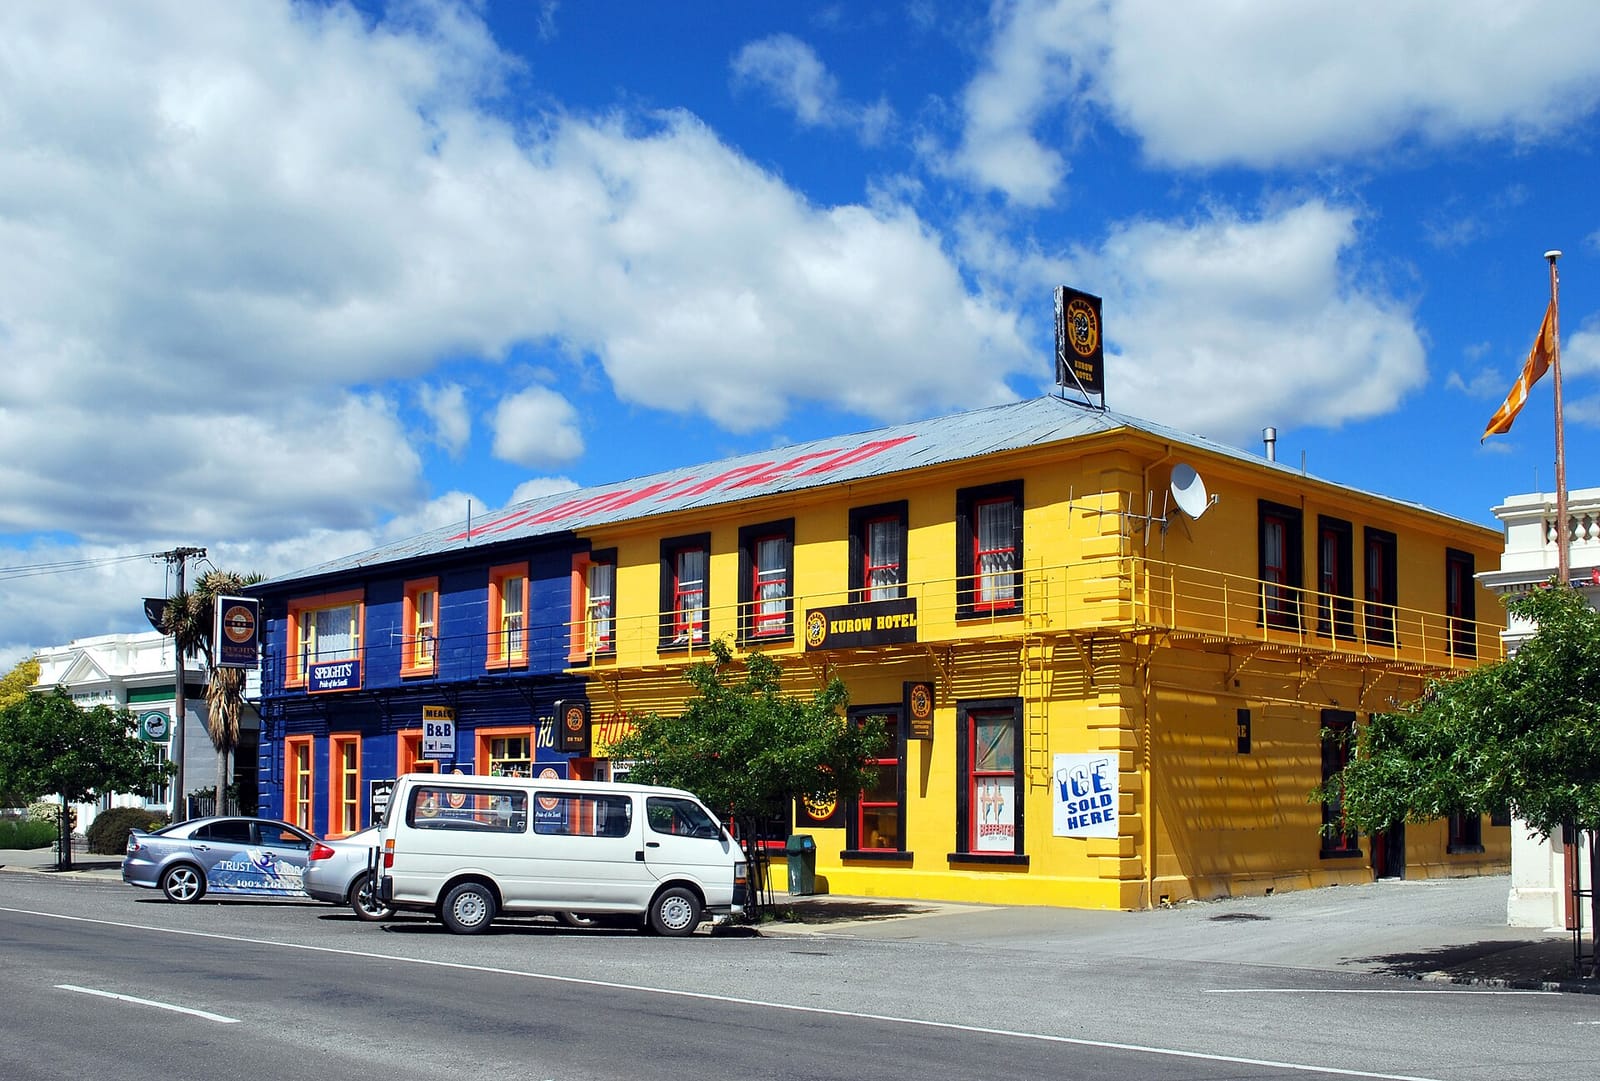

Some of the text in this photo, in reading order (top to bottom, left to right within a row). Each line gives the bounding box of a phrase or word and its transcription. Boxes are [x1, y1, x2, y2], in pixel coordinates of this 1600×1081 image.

[656, 435, 917, 503] RED
[830, 613, 917, 634] KUROW HOTEL
[314, 663, 353, 680] SPEIGHT'S
[425, 709, 454, 718] MEALS
[426, 723, 452, 737] B&B
[1056, 758, 1112, 802] ICE
[809, 805, 830, 817] BEER
[1067, 794, 1112, 814] SOLD
[1067, 808, 1115, 830] HERE
[980, 824, 1014, 837] BEEFEATER
[219, 860, 252, 871] TRUST
[236, 879, 261, 888] 100%
